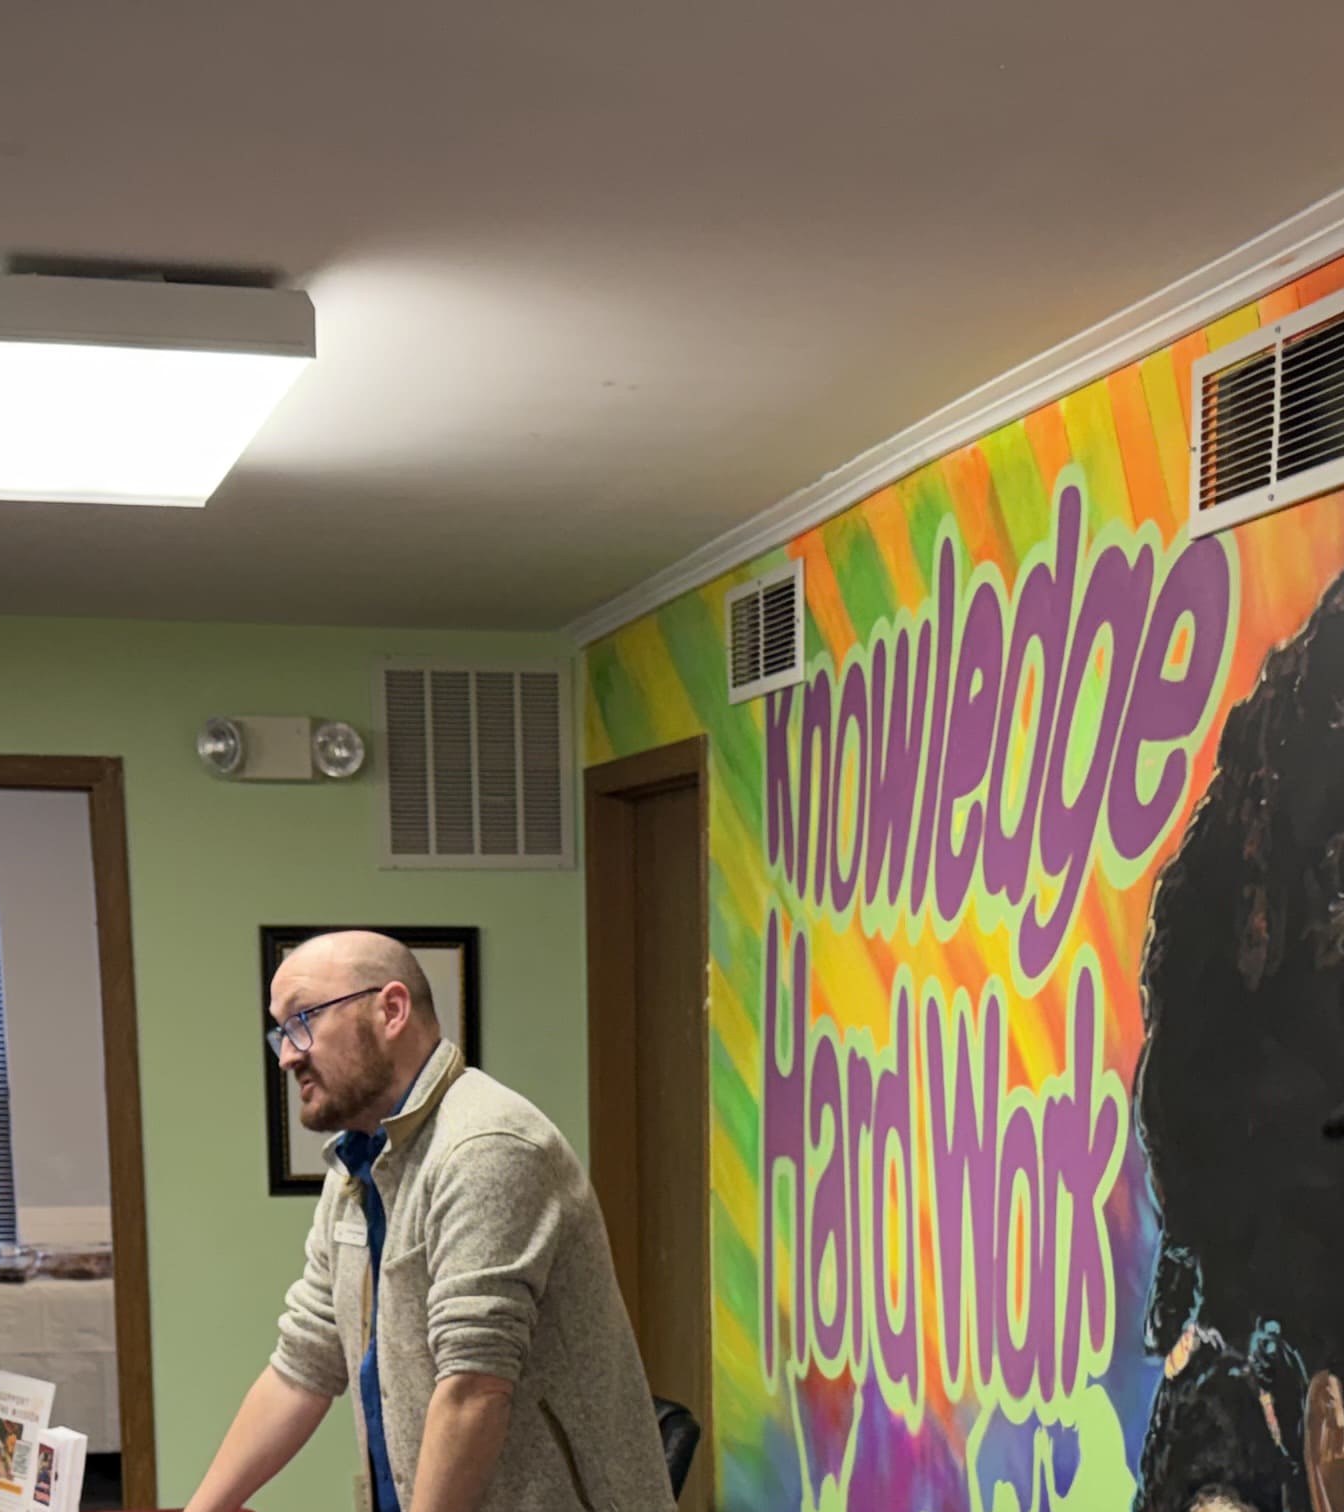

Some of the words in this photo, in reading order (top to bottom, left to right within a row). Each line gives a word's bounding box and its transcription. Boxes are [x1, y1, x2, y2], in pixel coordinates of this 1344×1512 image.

[762, 476, 1236, 988] Knowledge
[760, 900, 922, 1395] Hard
[922, 960, 1120, 1404] Work
